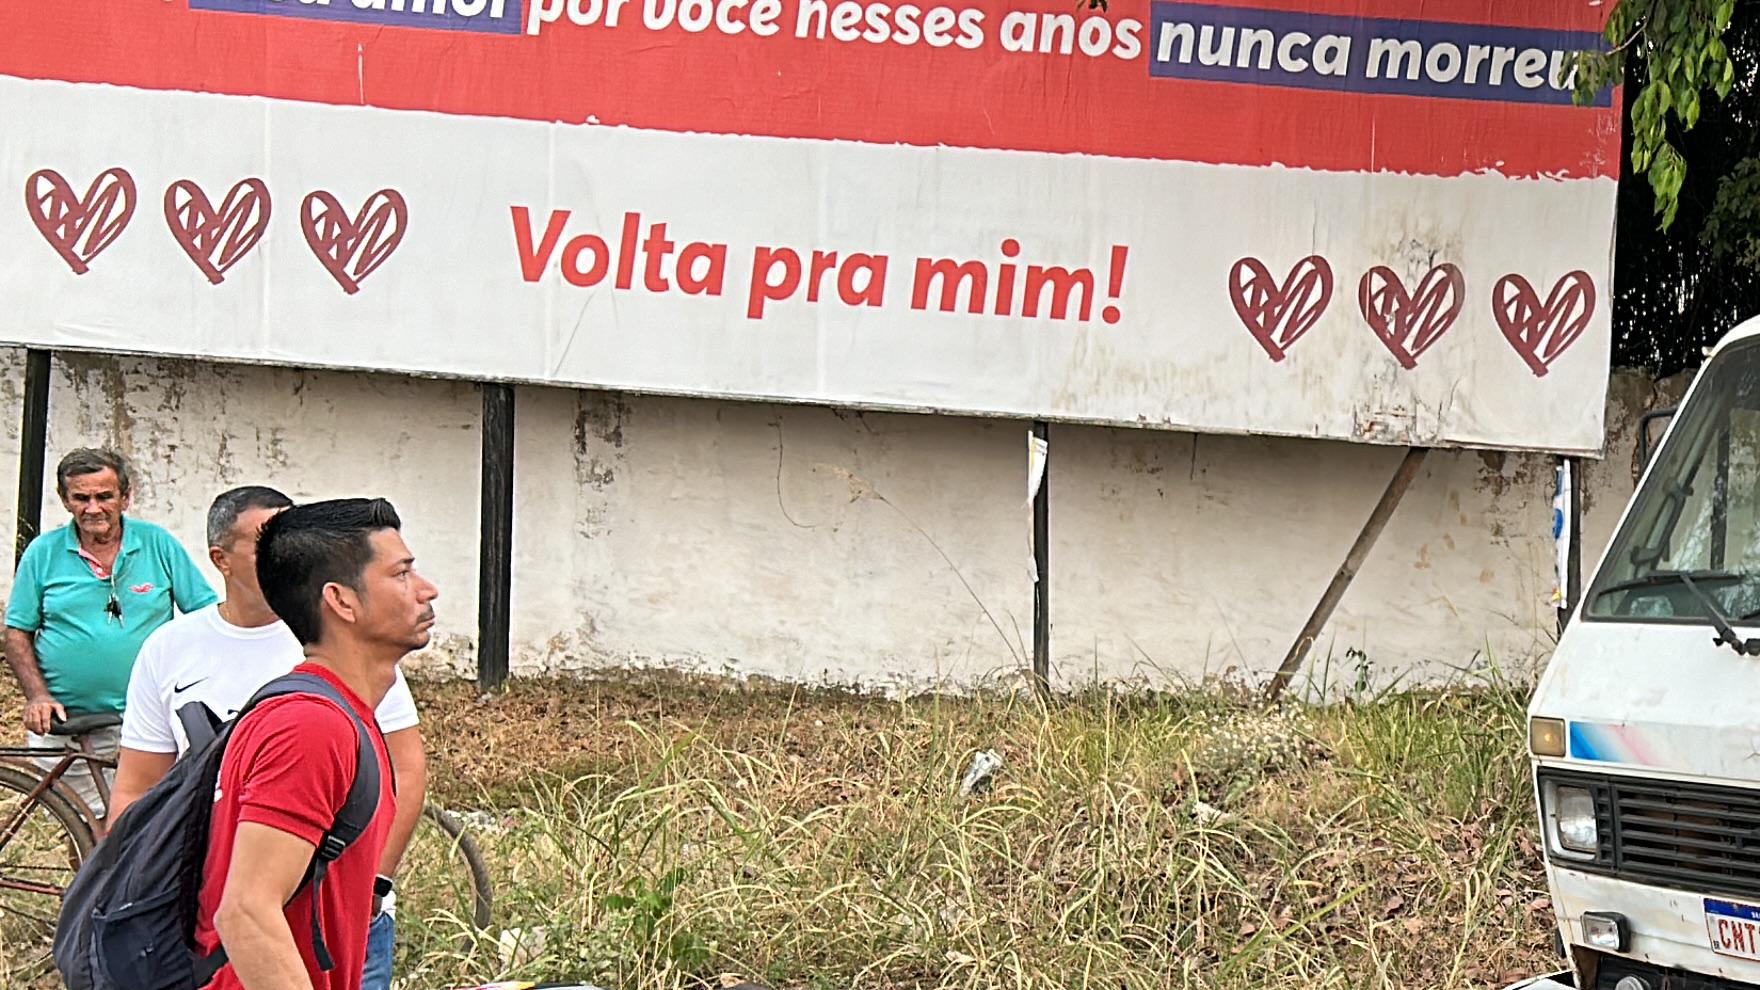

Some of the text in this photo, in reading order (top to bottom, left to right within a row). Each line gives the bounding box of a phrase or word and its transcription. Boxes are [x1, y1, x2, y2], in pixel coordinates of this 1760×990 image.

[795, 0, 985, 49] nesses
[1000, 10, 1143, 60] anos
[1157, 20, 1349, 77] nunca
[511, 206, 1129, 325] Volta pra mim!
